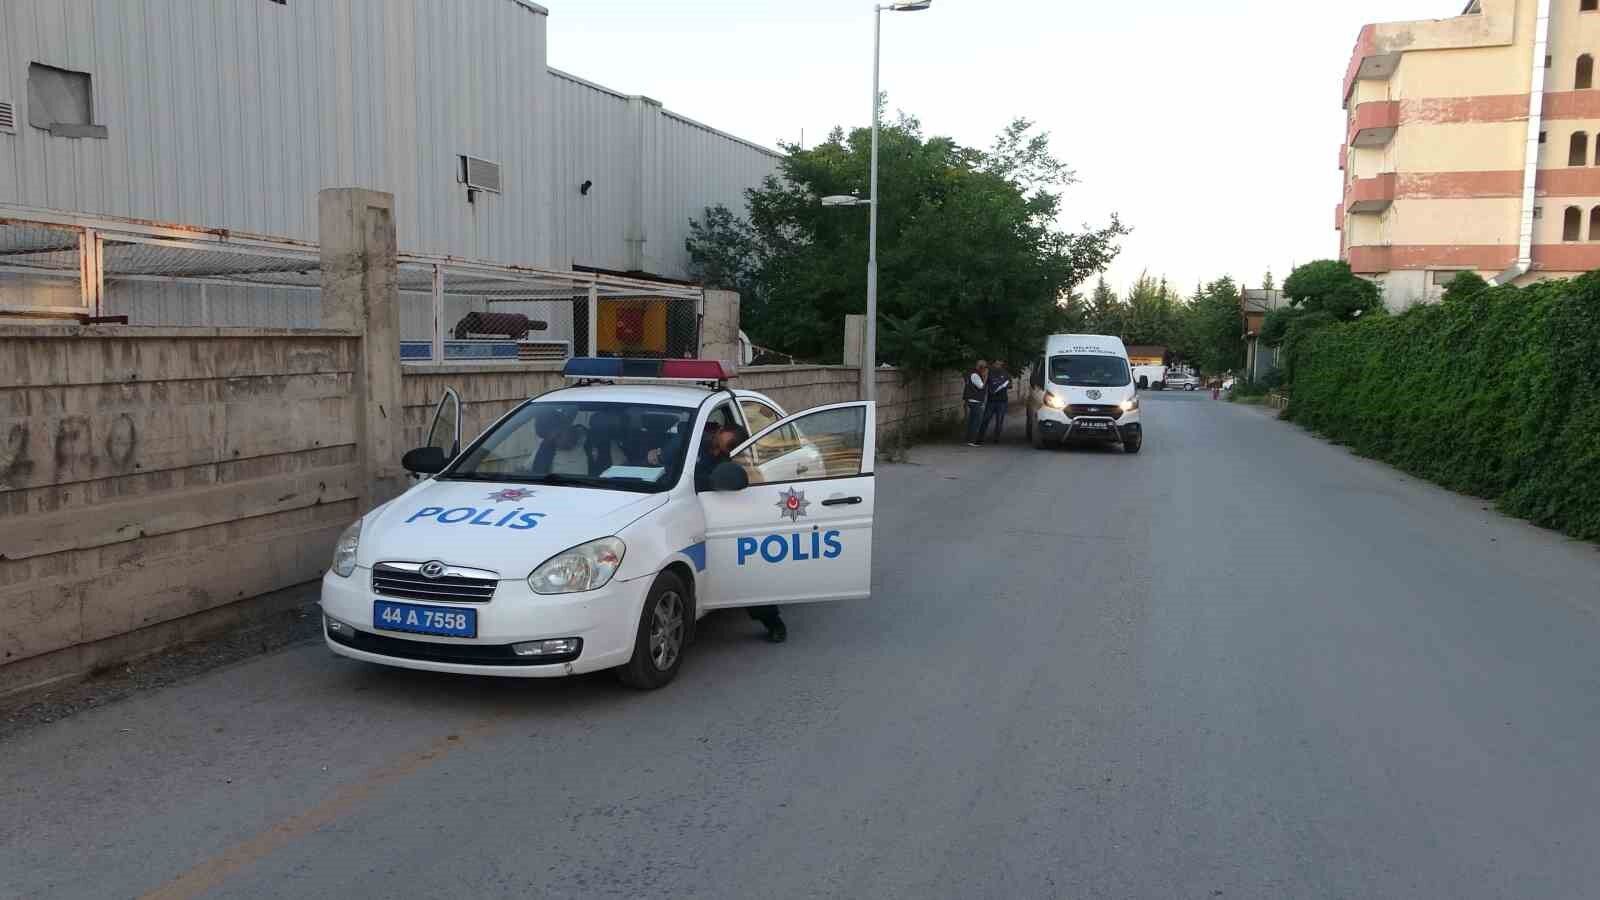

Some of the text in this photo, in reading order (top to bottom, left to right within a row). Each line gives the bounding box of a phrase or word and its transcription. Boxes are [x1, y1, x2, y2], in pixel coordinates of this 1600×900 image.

[405, 507, 547, 530] POLİS
[737, 525, 842, 565] POLİS
[382, 607, 466, 630] 44 A 7558
